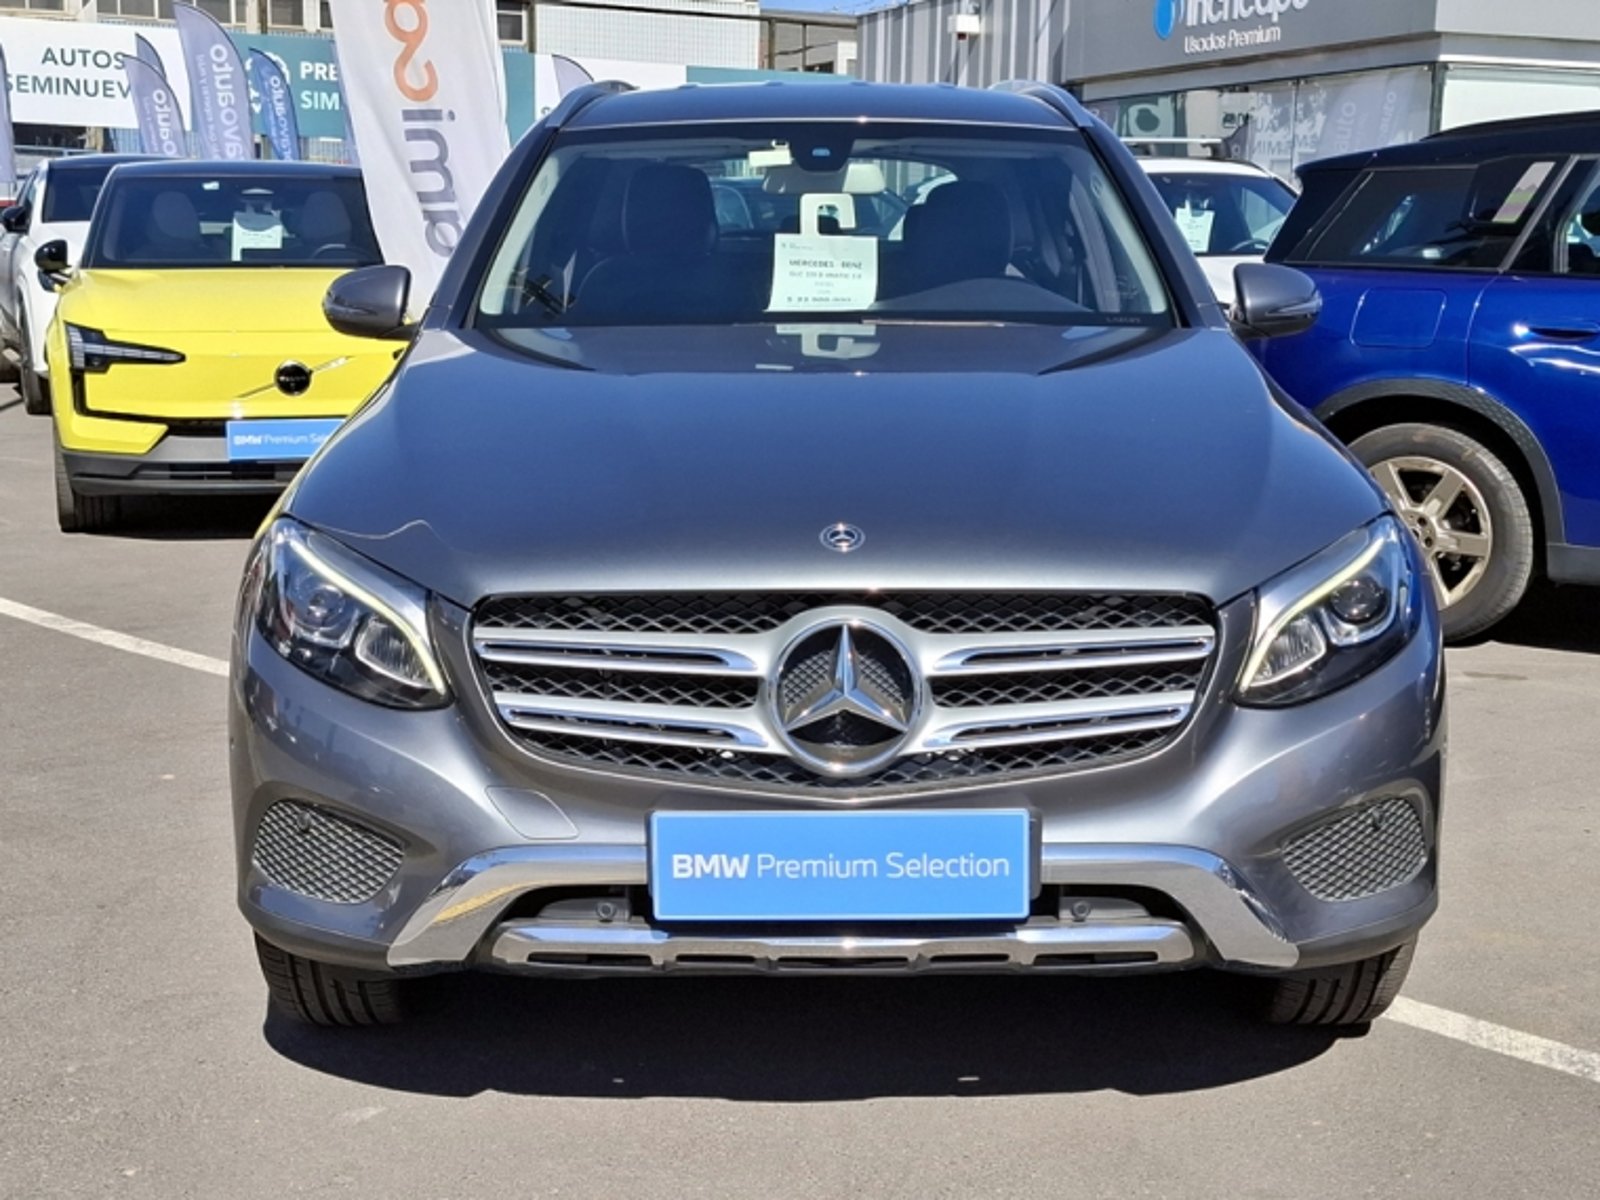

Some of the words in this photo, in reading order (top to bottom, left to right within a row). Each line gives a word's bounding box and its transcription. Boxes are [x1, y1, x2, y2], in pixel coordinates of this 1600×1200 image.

[1184, 34, 1226, 53] Usados
[1227, 25, 1281, 48] Premium
[41, 46, 125, 70] AUTOS
[233, 435, 262, 446] BMW
[265, 433, 308, 445] Premium
[672, 853, 750, 879] BMW
[756, 853, 878, 879] Premium
[885, 851, 1010, 879] Selection
